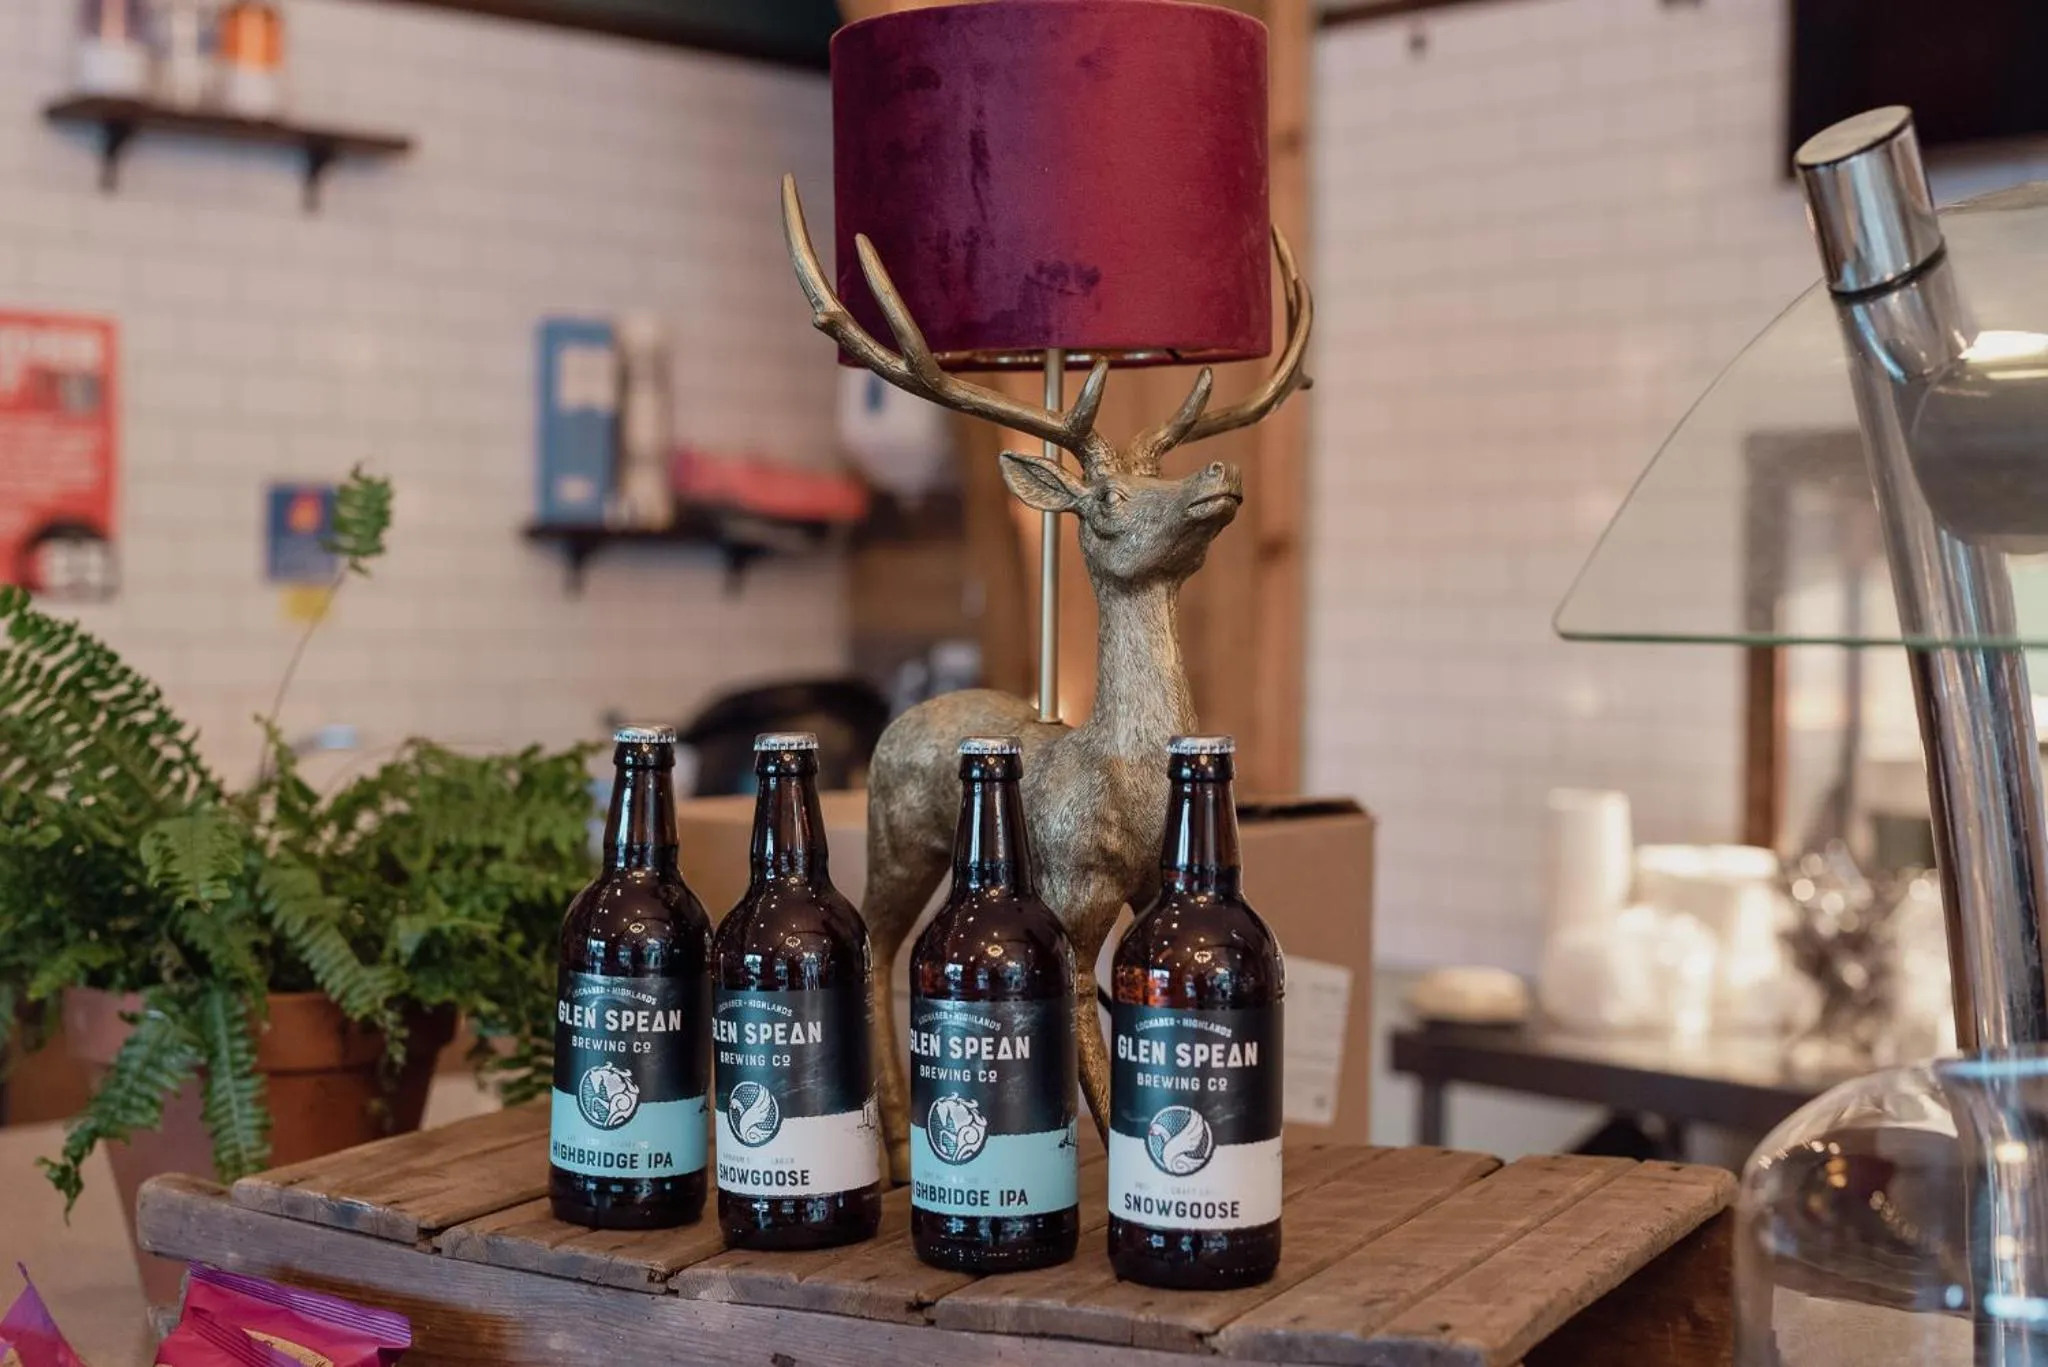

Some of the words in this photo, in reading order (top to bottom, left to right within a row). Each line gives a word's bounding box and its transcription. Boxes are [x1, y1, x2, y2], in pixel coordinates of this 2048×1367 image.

[557, 999, 596, 1030] GLEN
[605, 1008, 682, 1032] SPEAN
[572, 1035, 626, 1052] BREWING
[744, 1020, 822, 1045] SPEAN
[720, 1050, 766, 1067] BREWING
[949, 1036, 1030, 1060] SPEAN
[1118, 1034, 1166, 1066] GLEN
[1176, 1042, 1259, 1068] SPEAN
[920, 1064, 971, 1082] BREWING
[1136, 1074, 1200, 1092] BREWING
[552, 1141, 638, 1169] HIGHBRIDGE
[648, 1152, 674, 1168] IPA
[719, 1163, 810, 1187] SNOWGOOSE
[912, 1180, 990, 1207] GHBRIDGE
[1000, 1190, 1028, 1206] IPA
[1124, 1193, 1240, 1218] SNOWGOOSE
